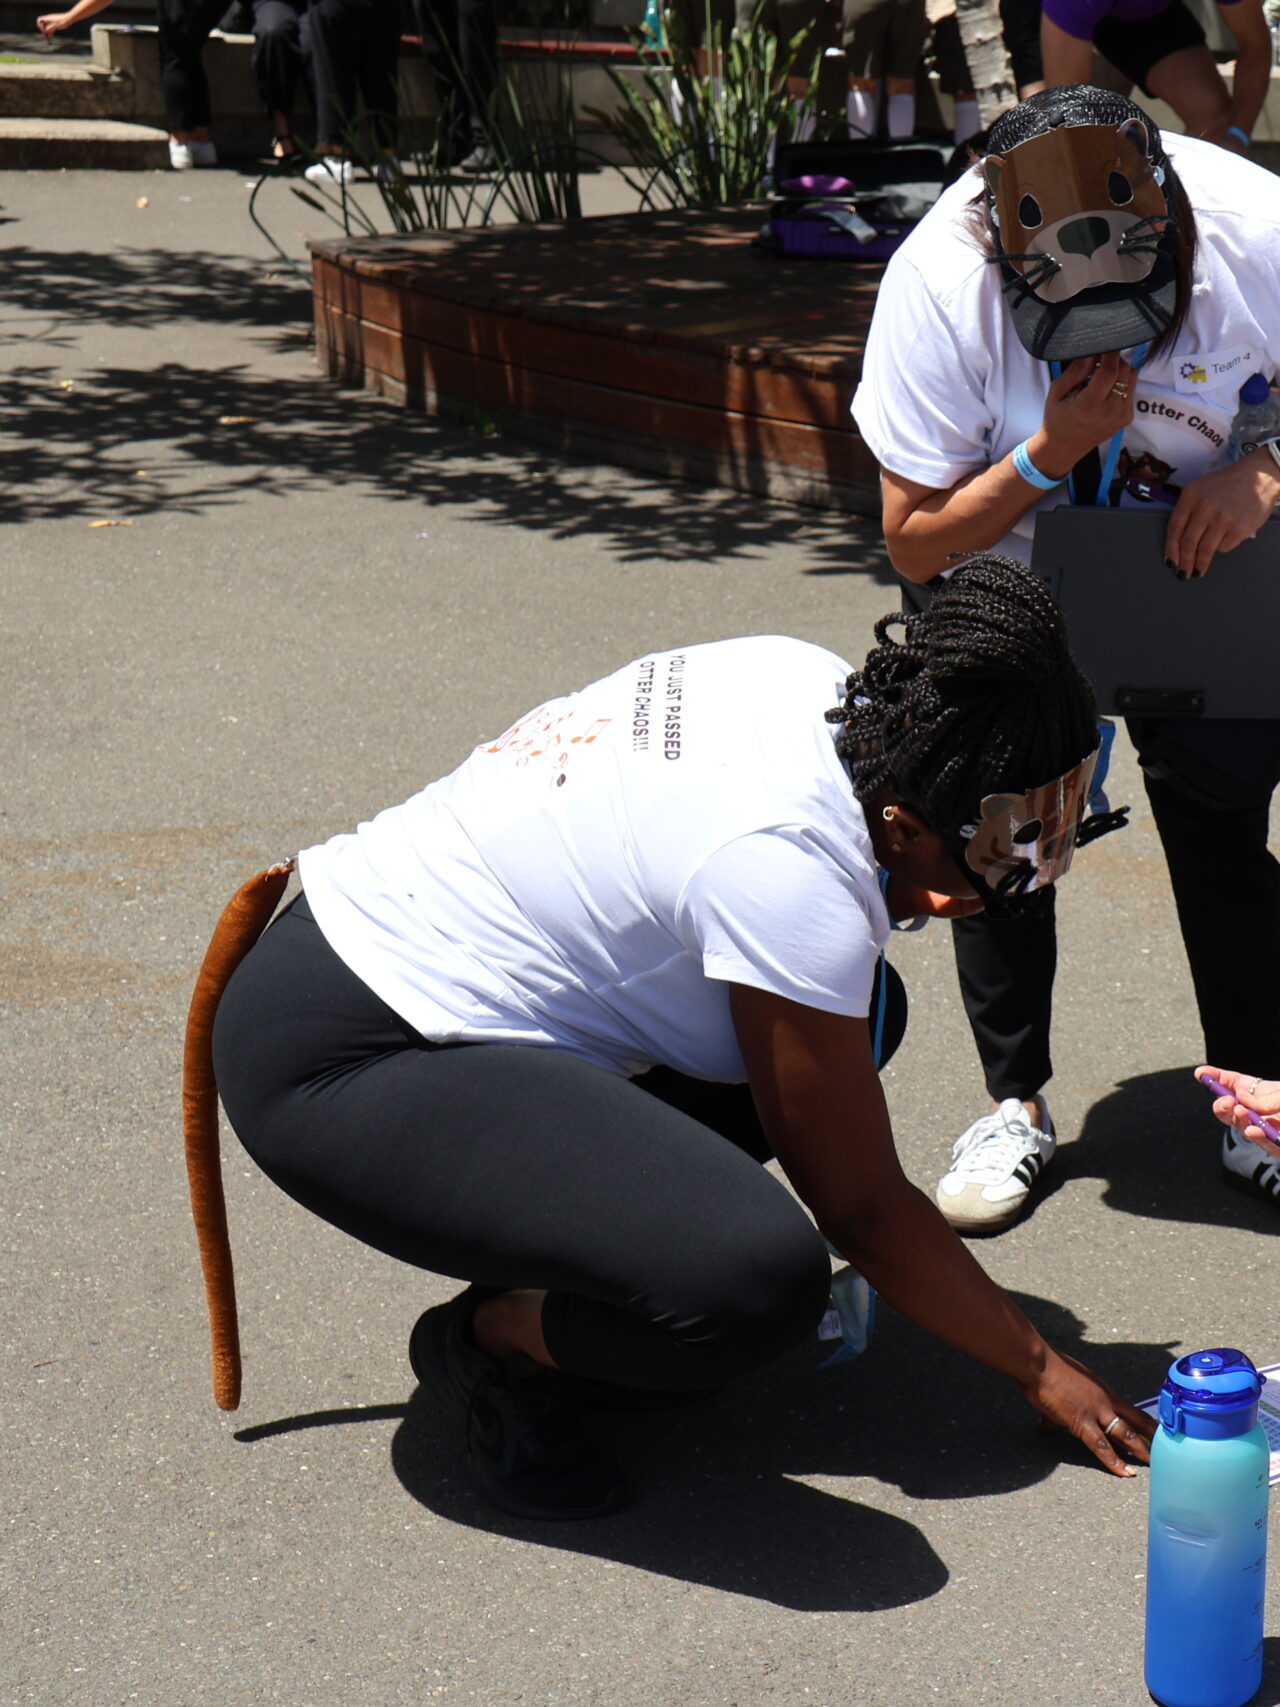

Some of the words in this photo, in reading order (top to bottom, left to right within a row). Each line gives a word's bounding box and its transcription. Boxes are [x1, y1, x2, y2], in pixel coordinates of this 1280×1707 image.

[1211, 355, 1241, 375] Team
[1136, 399, 1185, 421] Otter
[1187, 415, 1225, 449] Chaos
[636, 662, 655, 695] OTTER
[670, 655, 686, 674] YOU
[666, 676, 682, 702] JUST
[632, 697, 651, 752] CHAOS!!!
[664, 705, 681, 760] PASSED
